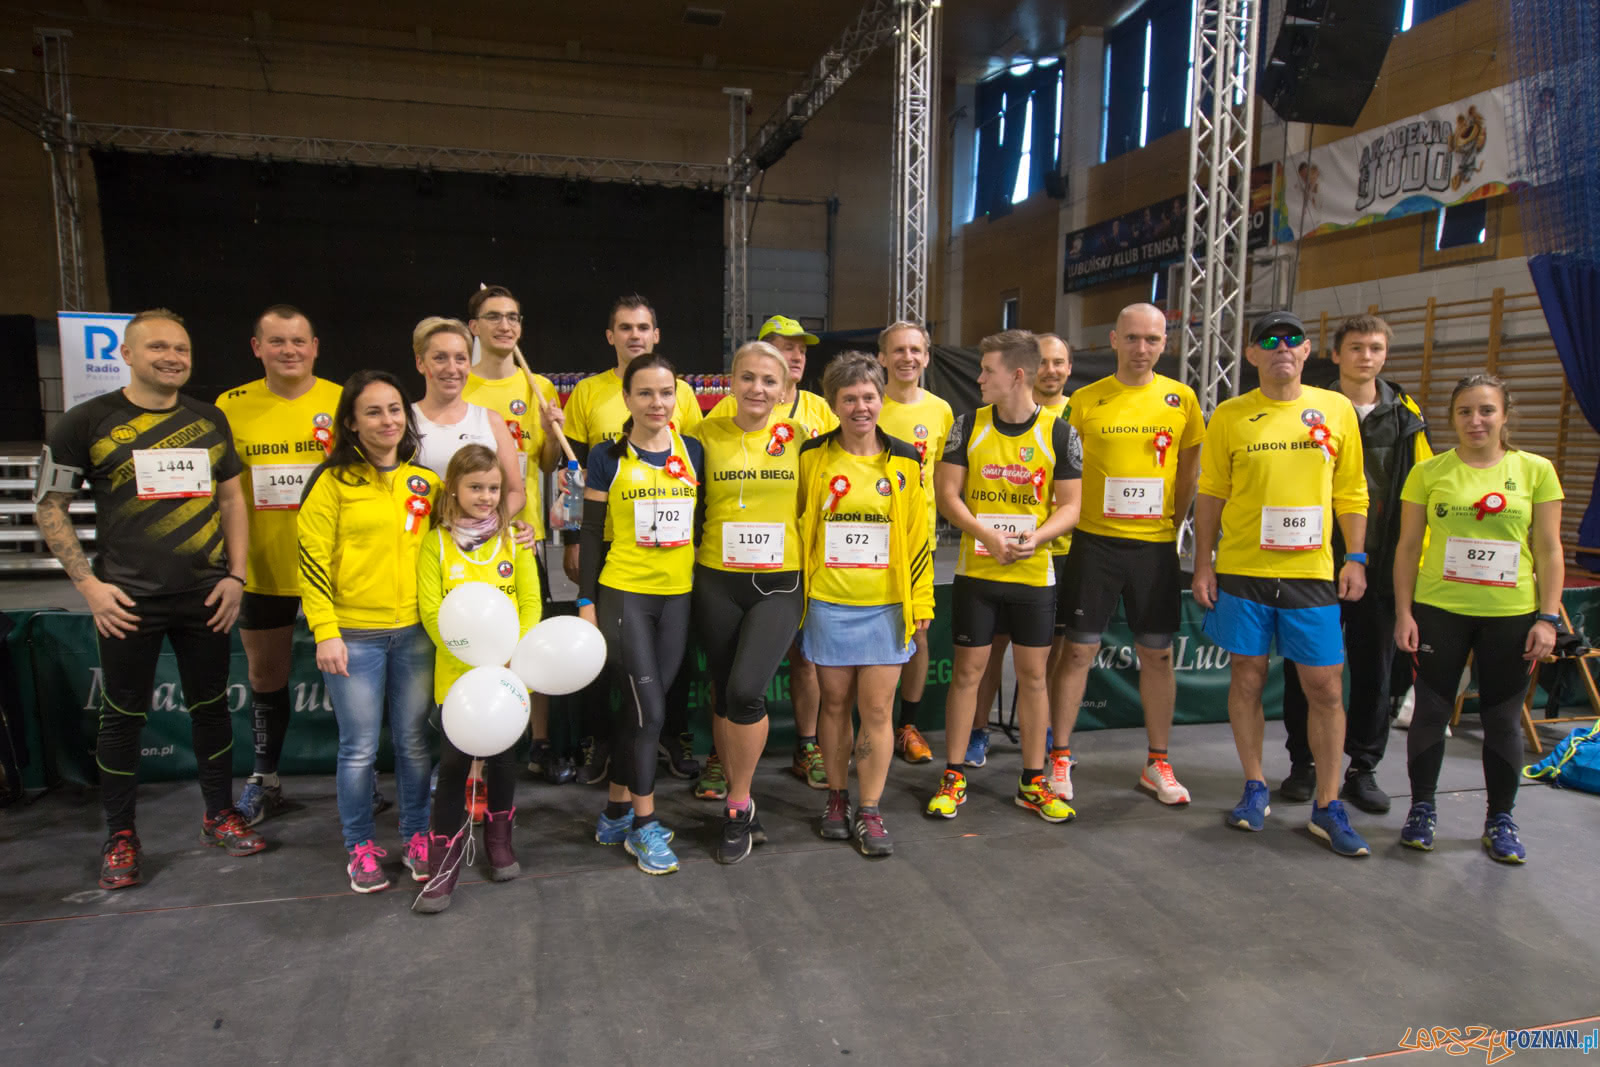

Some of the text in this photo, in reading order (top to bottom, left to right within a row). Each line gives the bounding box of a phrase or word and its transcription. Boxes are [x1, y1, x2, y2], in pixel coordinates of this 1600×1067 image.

[1359, 120, 1454, 176] AKADEMIA
[1355, 143, 1454, 211] JUDO
[1112, 248, 1139, 266] KLUB
[1142, 236, 1180, 259] TENISA
[86, 364, 120, 373] Radio
[245, 440, 324, 456] LUBOŃ BIEG
[1290, 441, 1320, 450] BIEG
[157, 460, 194, 472] 1444
[269, 475, 304, 486] 1404
[713, 468, 795, 481] LUBOŃ BIEGA
[671, 487, 697, 497] BIEG
[1123, 488, 1145, 498] 673
[1011, 493, 1041, 506] BIEG
[657, 510, 680, 522] 702
[1283, 517, 1306, 528] 868
[739, 533, 770, 544] 1107
[845, 534, 869, 544] 672
[1467, 549, 1496, 561] 827
